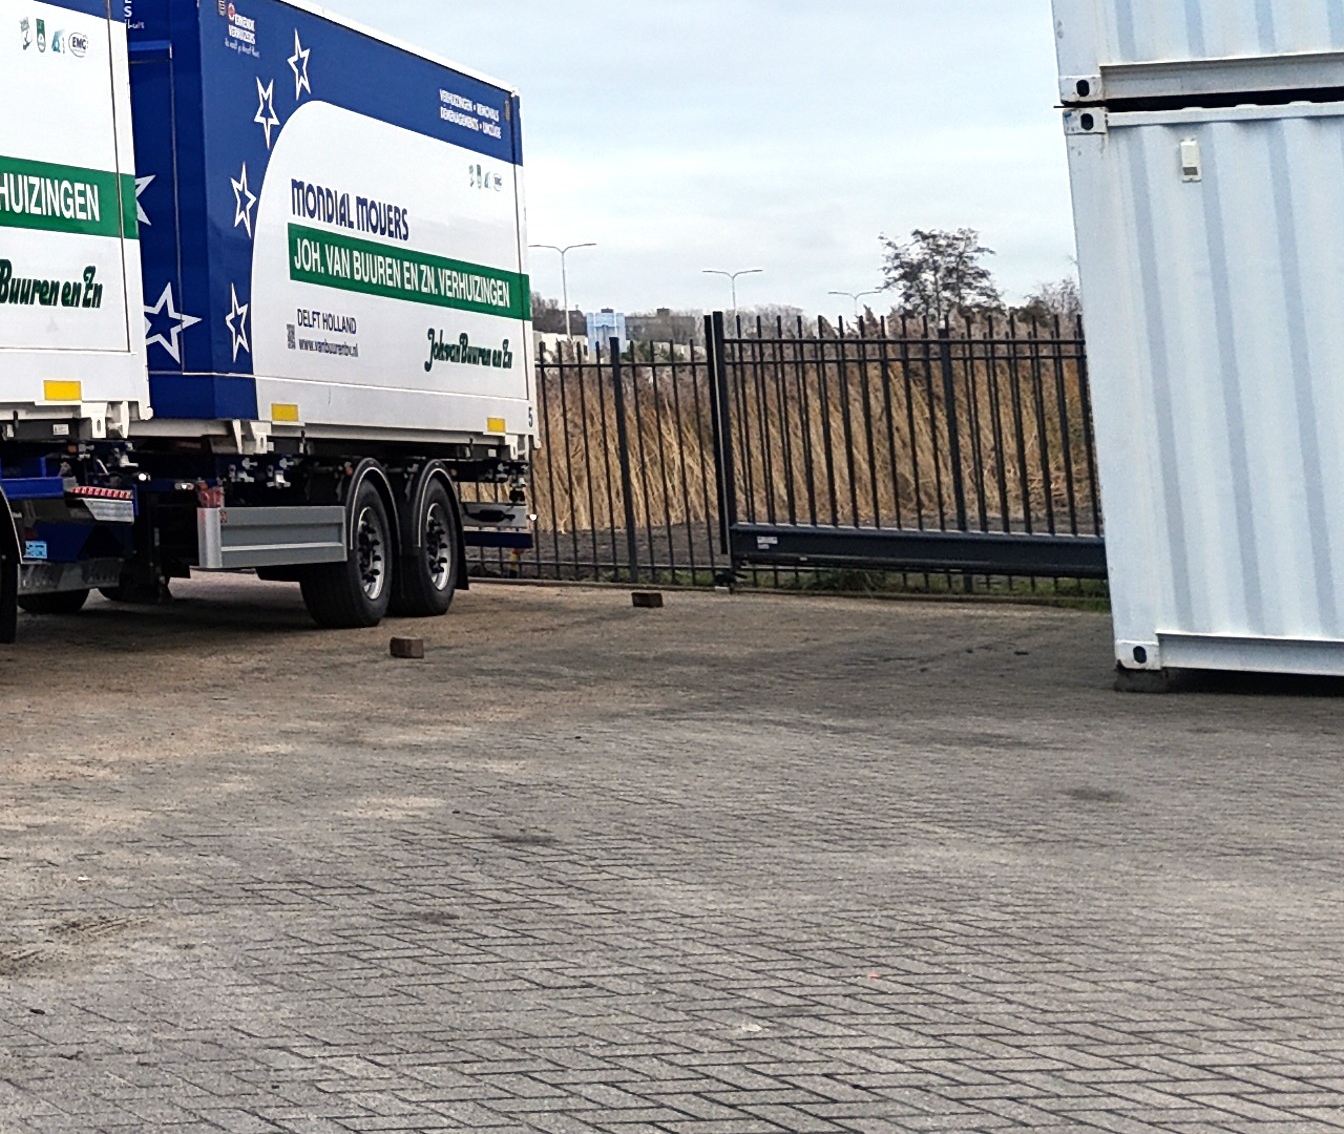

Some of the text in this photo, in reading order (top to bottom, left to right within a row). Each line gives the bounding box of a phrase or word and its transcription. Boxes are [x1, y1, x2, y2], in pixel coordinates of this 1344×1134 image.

[293, 237, 511, 309] JOH. VAN BUUREN EN ZN. VERHUIZINGEN
[297, 308, 357, 335] DELFT HOLLAND
[527, 406, 534, 428] 5
